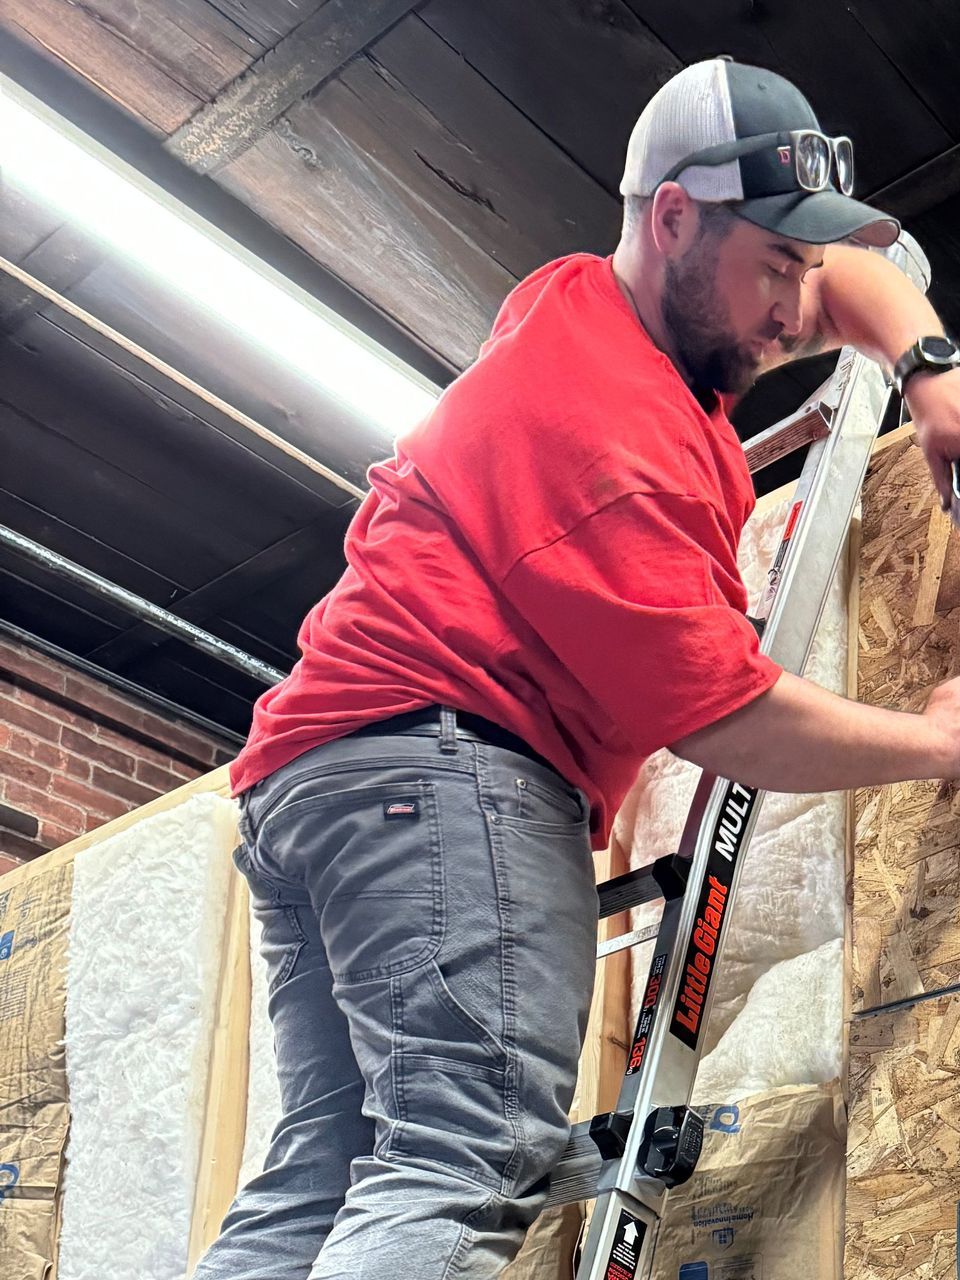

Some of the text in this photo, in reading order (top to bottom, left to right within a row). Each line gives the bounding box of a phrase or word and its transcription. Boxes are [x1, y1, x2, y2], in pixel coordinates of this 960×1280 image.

[692, 874, 728, 951] Giant
[643, 974, 661, 1009] 300
[675, 951, 711, 1035] Little
